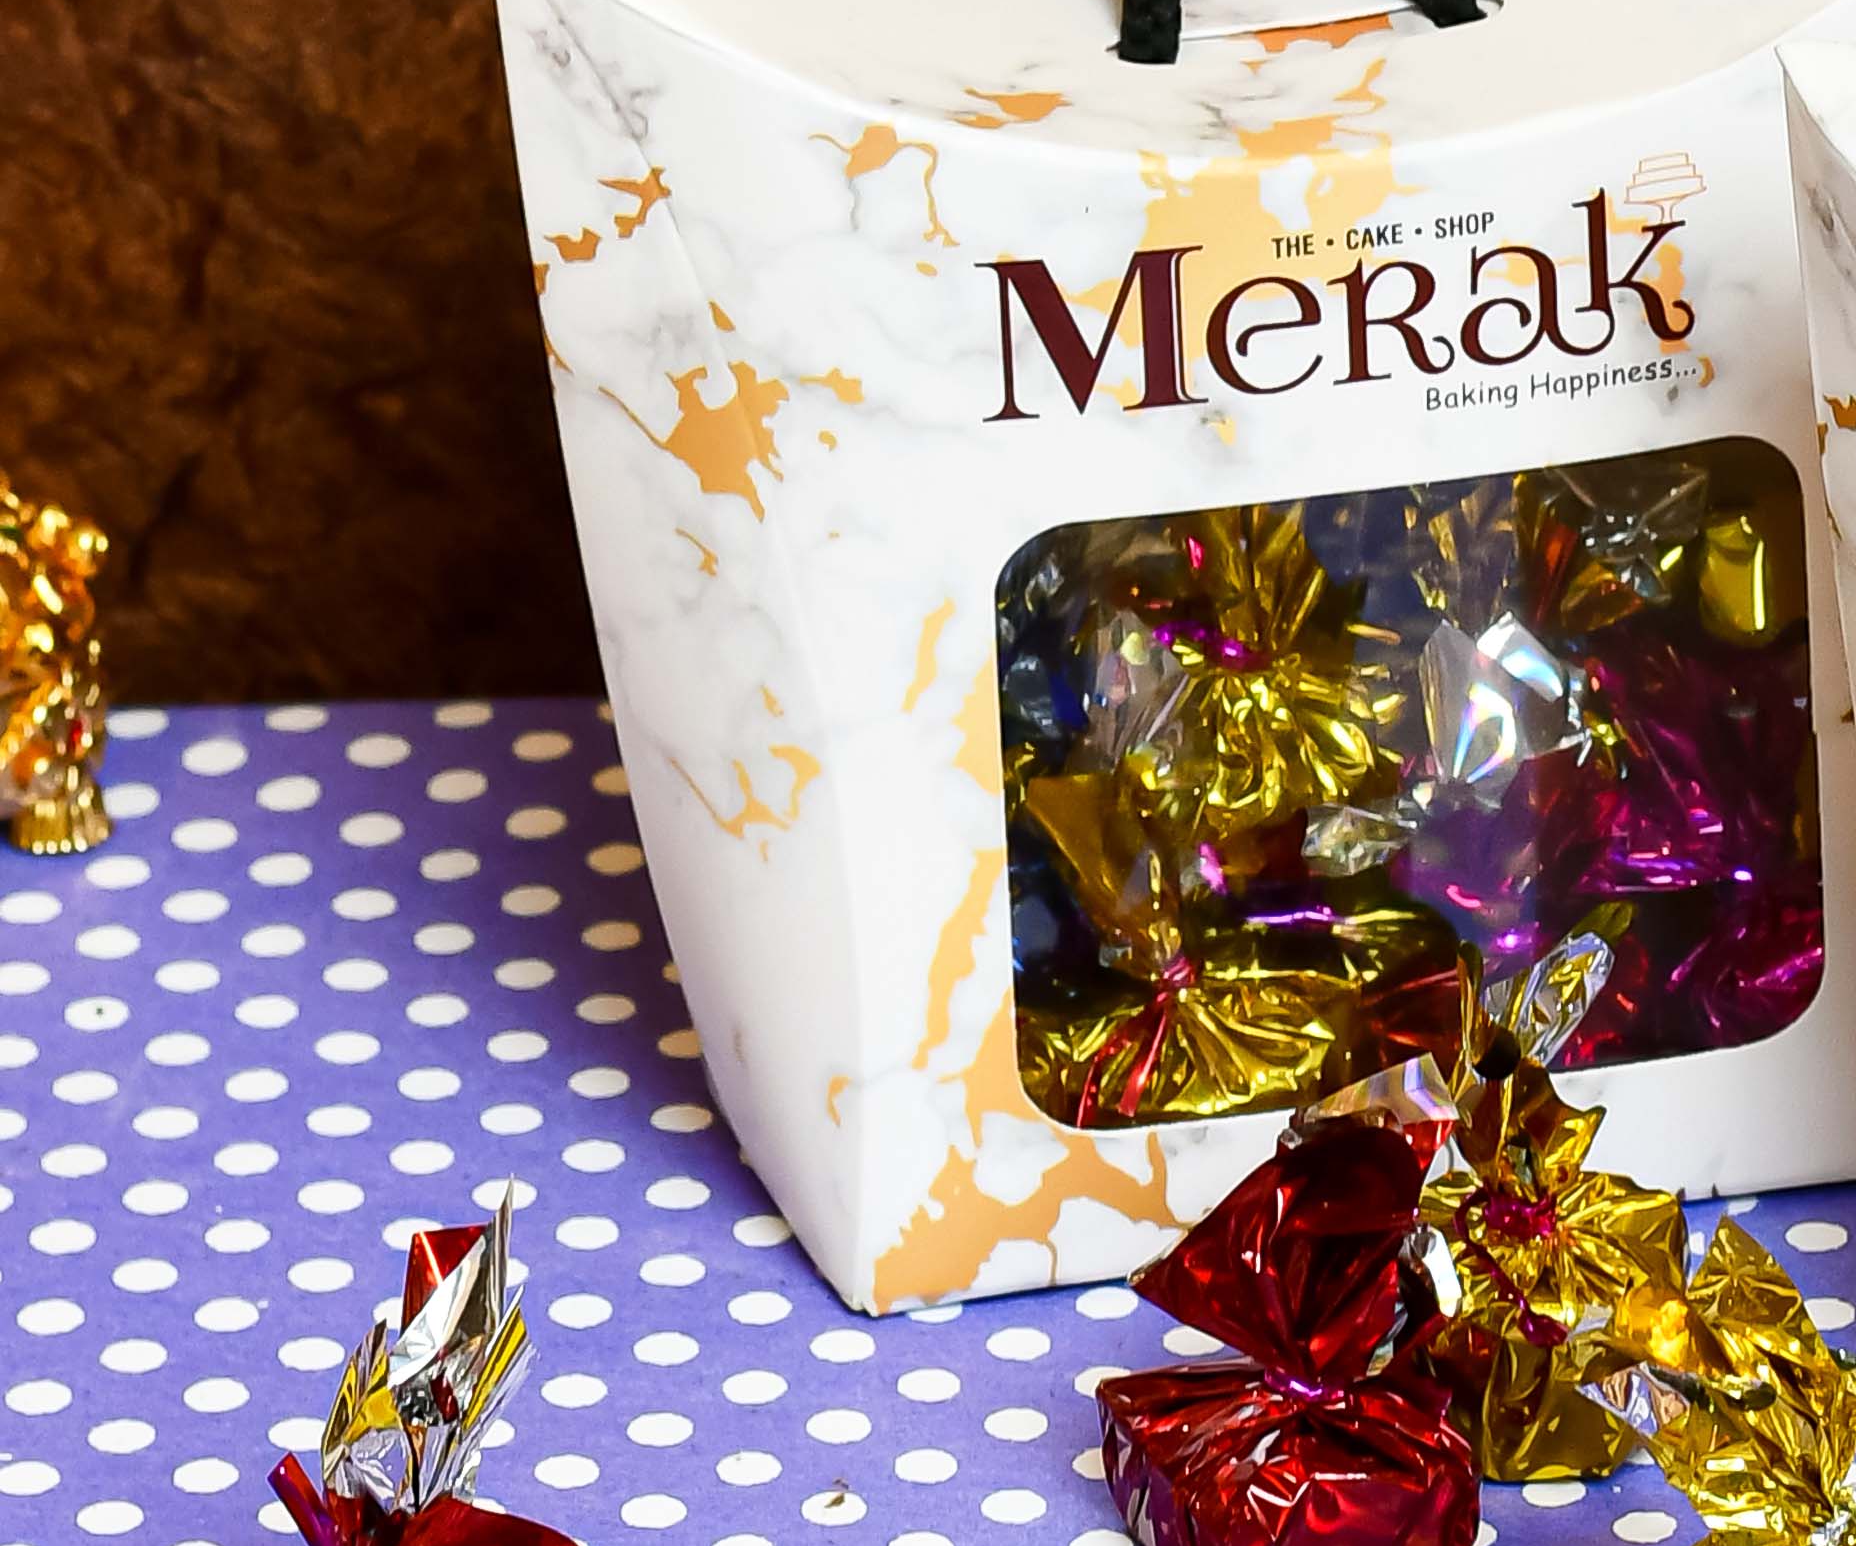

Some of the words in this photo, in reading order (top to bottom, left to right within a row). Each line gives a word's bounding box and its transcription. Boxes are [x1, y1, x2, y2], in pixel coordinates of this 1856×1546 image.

[1272, 234, 1315, 259] THE
[1346, 223, 1404, 250] CAKE
[1435, 211, 1495, 239] SHOP
[1426, 384, 1518, 411] Baking
[1530, 358, 1698, 402] Happiness...
